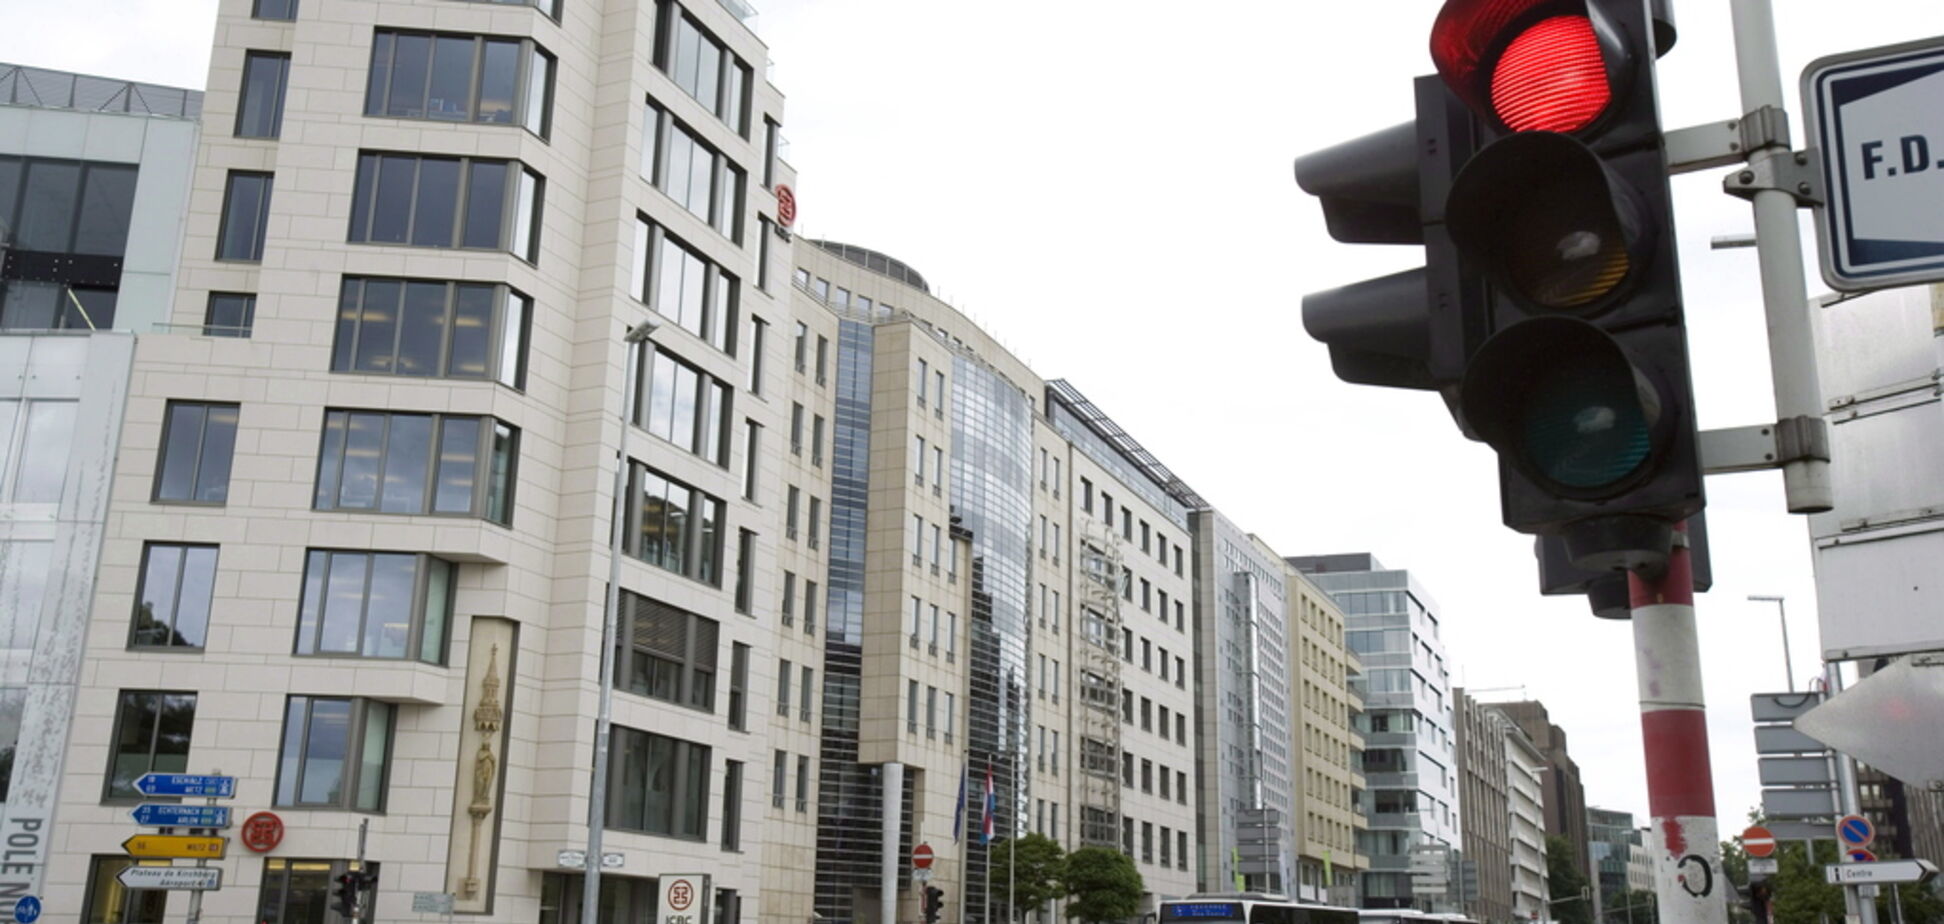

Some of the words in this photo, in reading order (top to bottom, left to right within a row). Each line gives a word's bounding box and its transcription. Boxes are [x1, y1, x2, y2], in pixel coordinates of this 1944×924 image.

[130, 869, 162, 877] Plateau
[176, 870, 216, 879] Kirchberg
[1846, 869, 1873, 878] Centre
